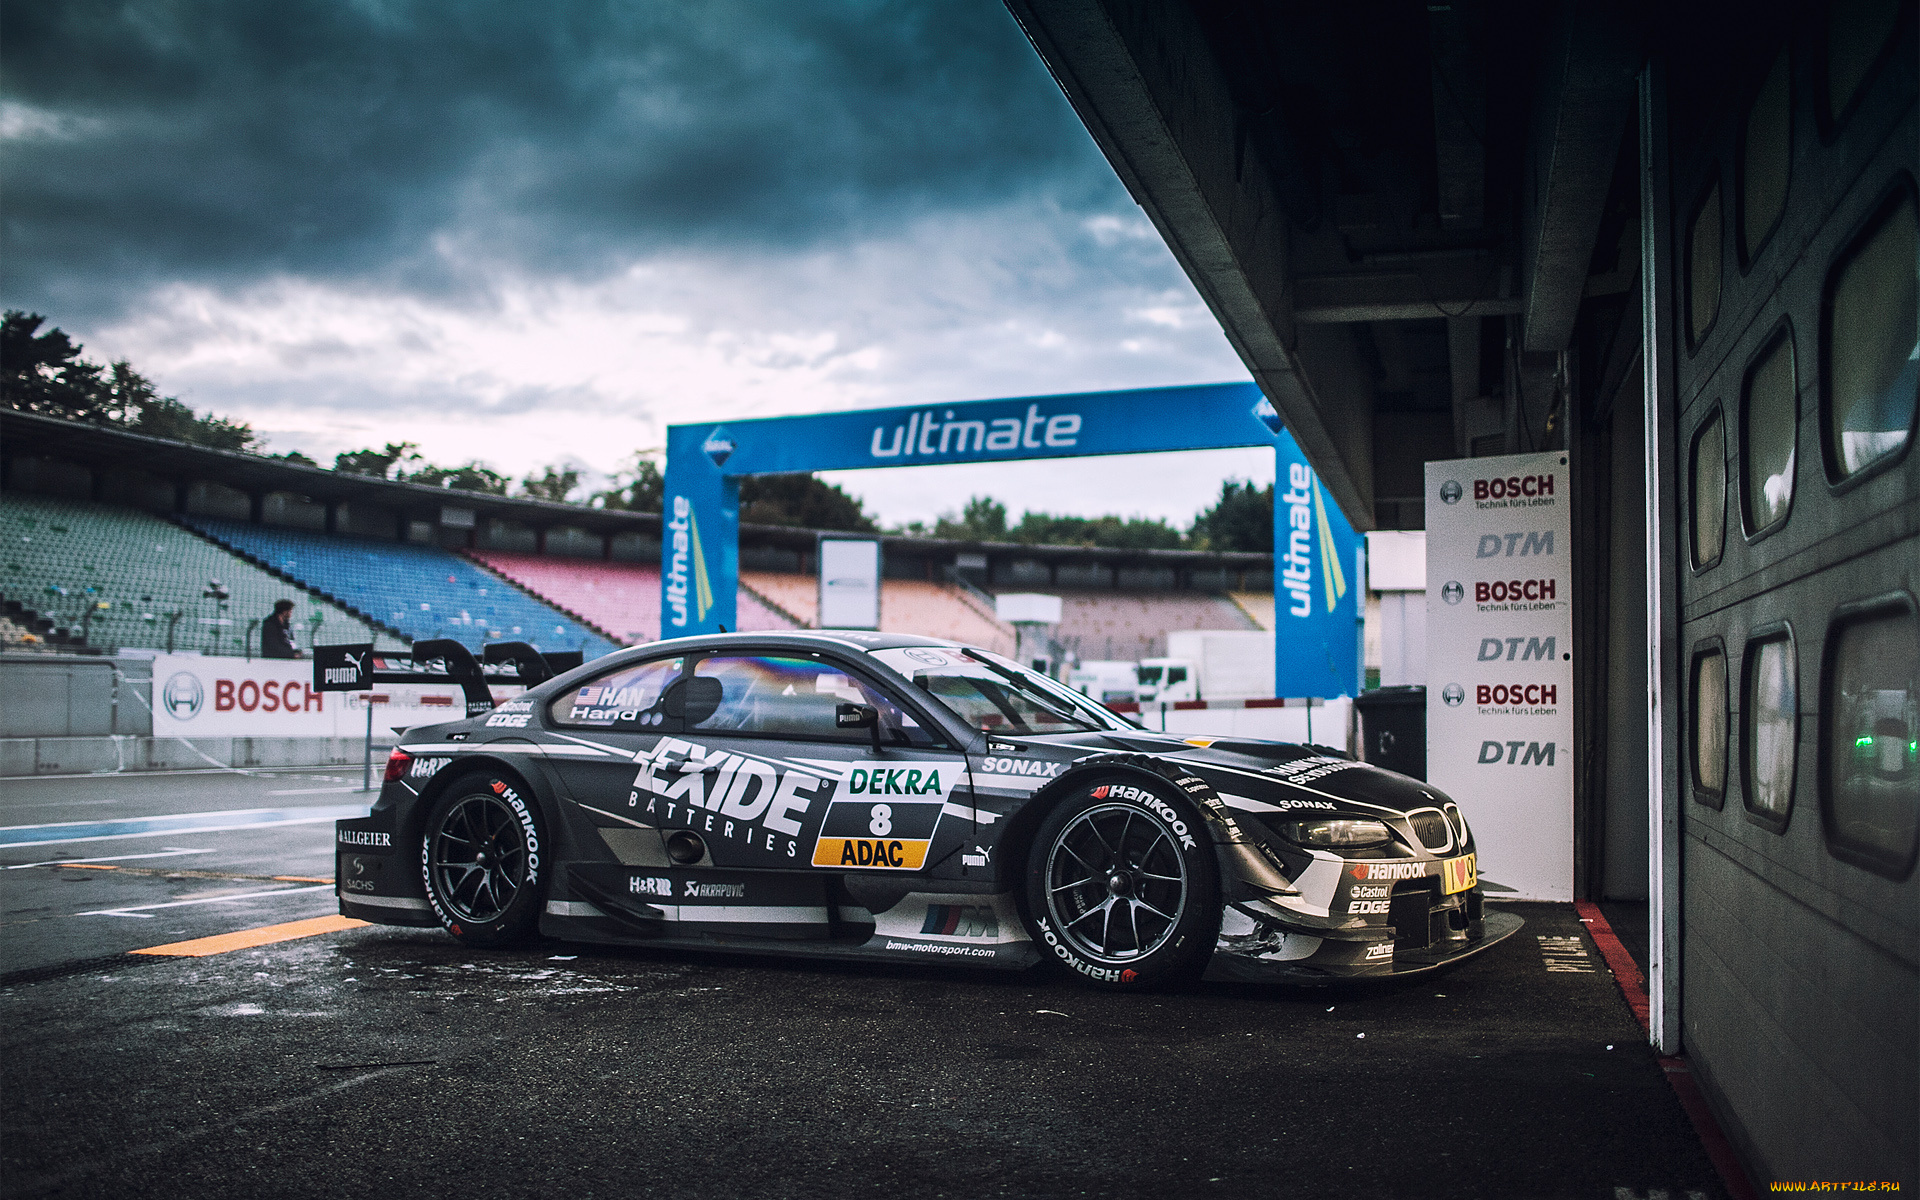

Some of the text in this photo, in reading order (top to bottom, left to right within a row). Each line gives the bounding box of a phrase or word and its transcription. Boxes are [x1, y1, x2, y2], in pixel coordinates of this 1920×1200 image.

[871, 404, 1082, 457] ultimate
[1474, 474, 1554, 500] BOSCH
[1475, 497, 1555, 510] Technik fürs Leben
[1283, 462, 1311, 617] ultimate
[1475, 530, 1554, 559] DTM
[667, 495, 690, 627] ultimate
[1475, 579, 1555, 602] BOSCH
[1476, 601, 1555, 612] Technik fürs Leben
[1477, 636, 1555, 661] DTM
[325, 667, 357, 684] PUMA
[215, 679, 323, 712] BOSCH
[598, 686, 645, 706] HAN
[1476, 684, 1557, 705] BOSCH
[569, 706, 639, 721] Hand
[839, 714, 861, 723] PUMA
[1477, 706, 1557, 715] Technik fürs Leben
[485, 714, 532, 728] EDGE
[1477, 740, 1556, 766] DTM
[410, 757, 439, 778] H&R
[982, 757, 1060, 776] SONAX
[633, 736, 821, 837] EXIDE
[850, 769, 942, 795] DEKRA
[1280, 800, 1337, 811] SONAX
[628, 791, 797, 857] BATTERIES
[869, 804, 892, 836] 8
[344, 830, 391, 847] ALLGEIER
[840, 840, 904, 867] ADAC
[962, 854, 986, 867] PUMA
[346, 879, 375, 891] SACHS
[629, 876, 656, 894] H&R
[1360, 886, 1388, 898] Castrol
[1348, 900, 1391, 914] EDGE
[886, 940, 996, 958] bmw-motorsport.com
